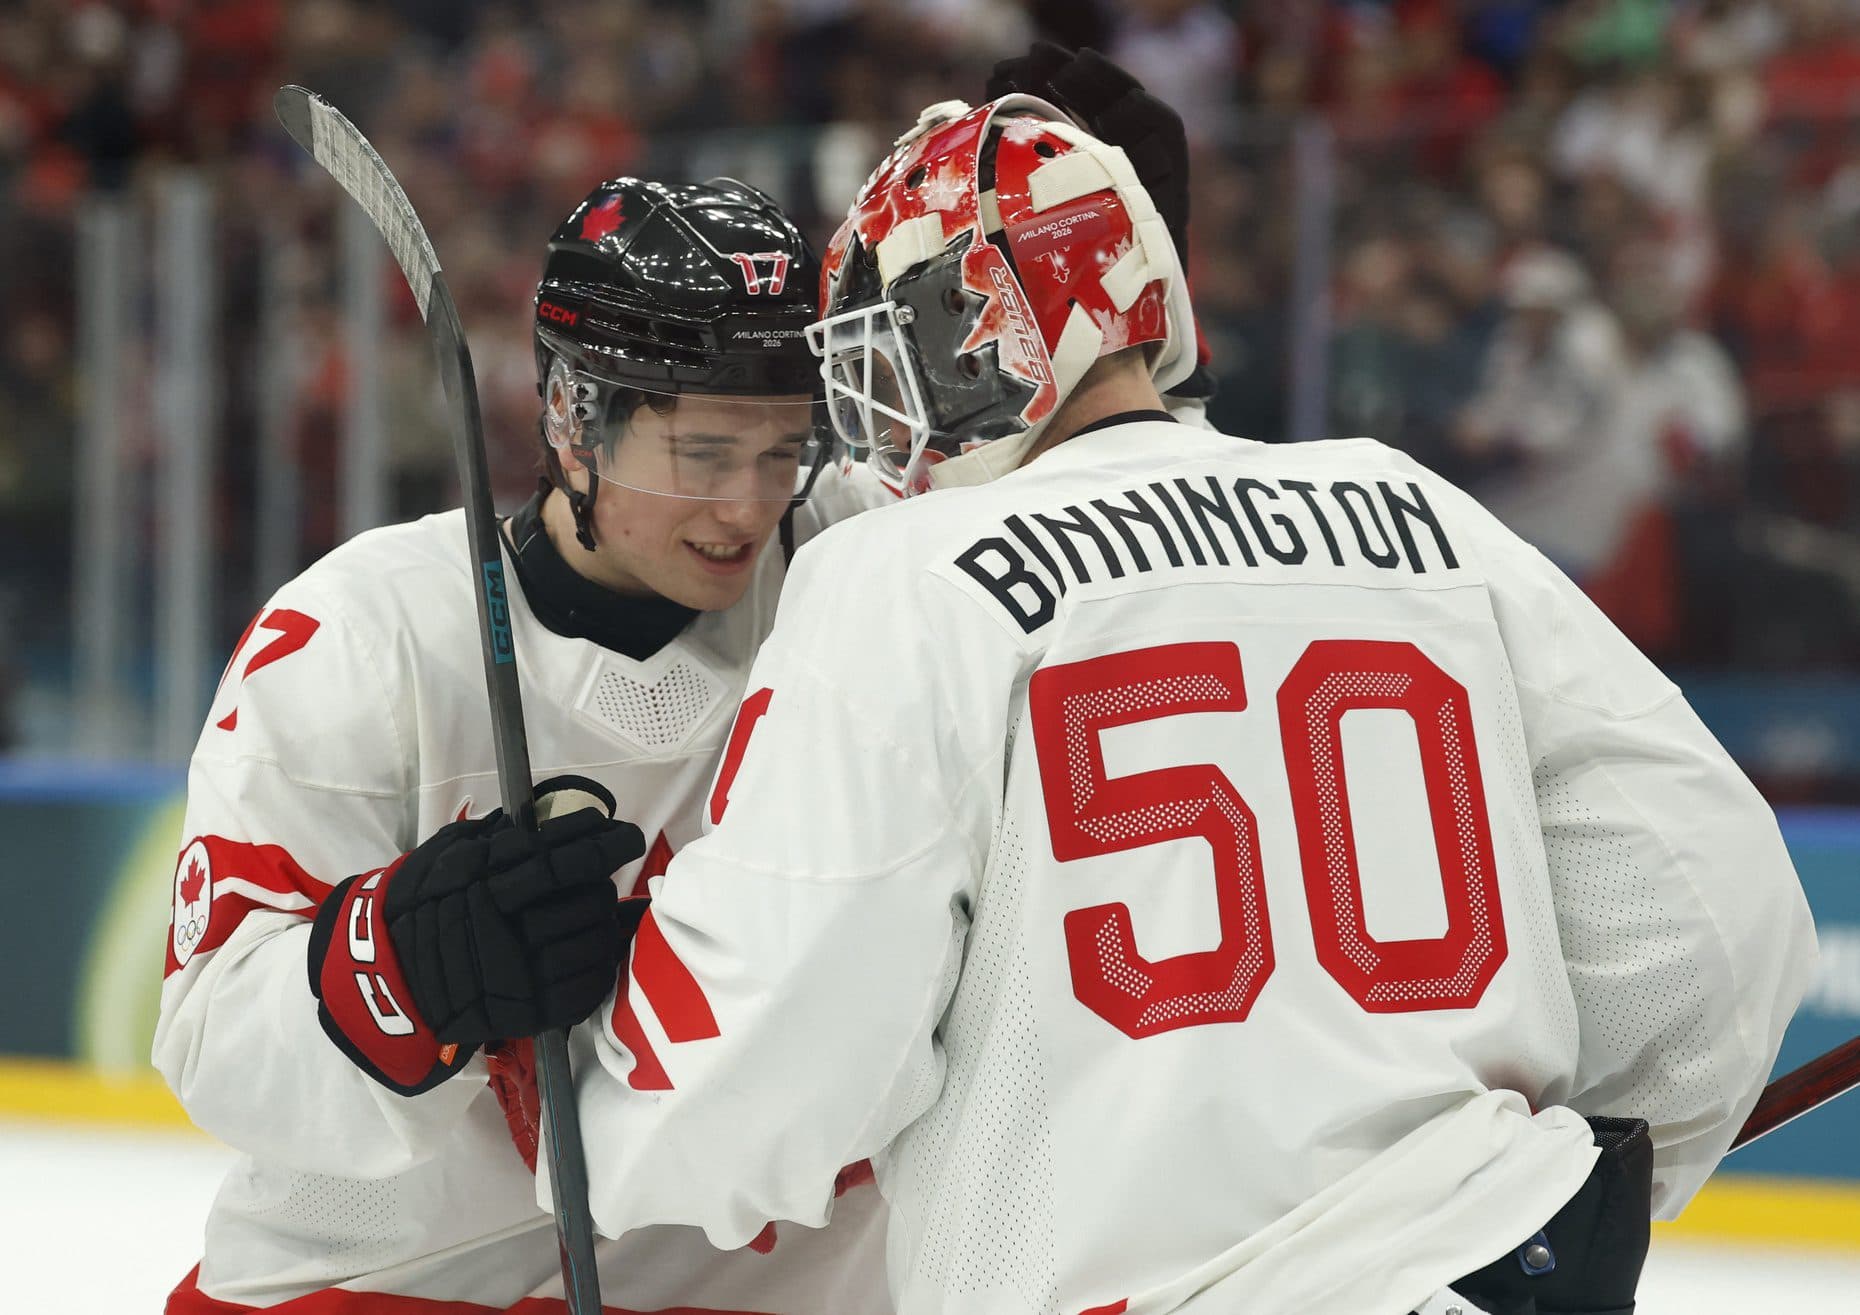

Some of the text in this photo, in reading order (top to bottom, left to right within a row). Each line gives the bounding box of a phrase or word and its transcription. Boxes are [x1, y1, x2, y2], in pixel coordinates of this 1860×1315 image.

[1017, 211, 1100, 243] MILANO CORTINA
[1051, 227, 1073, 240] 2026
[730, 251, 789, 295] 17
[540, 302, 577, 327] CCM
[732, 330, 806, 339] MILANO CORTIN
[763, 339, 782, 348] 2026
[953, 475, 1461, 635] BINNINGTON
[486, 570, 511, 656] CCM
[1029, 639, 1509, 1040] 50
[348, 870, 416, 1037] CC
